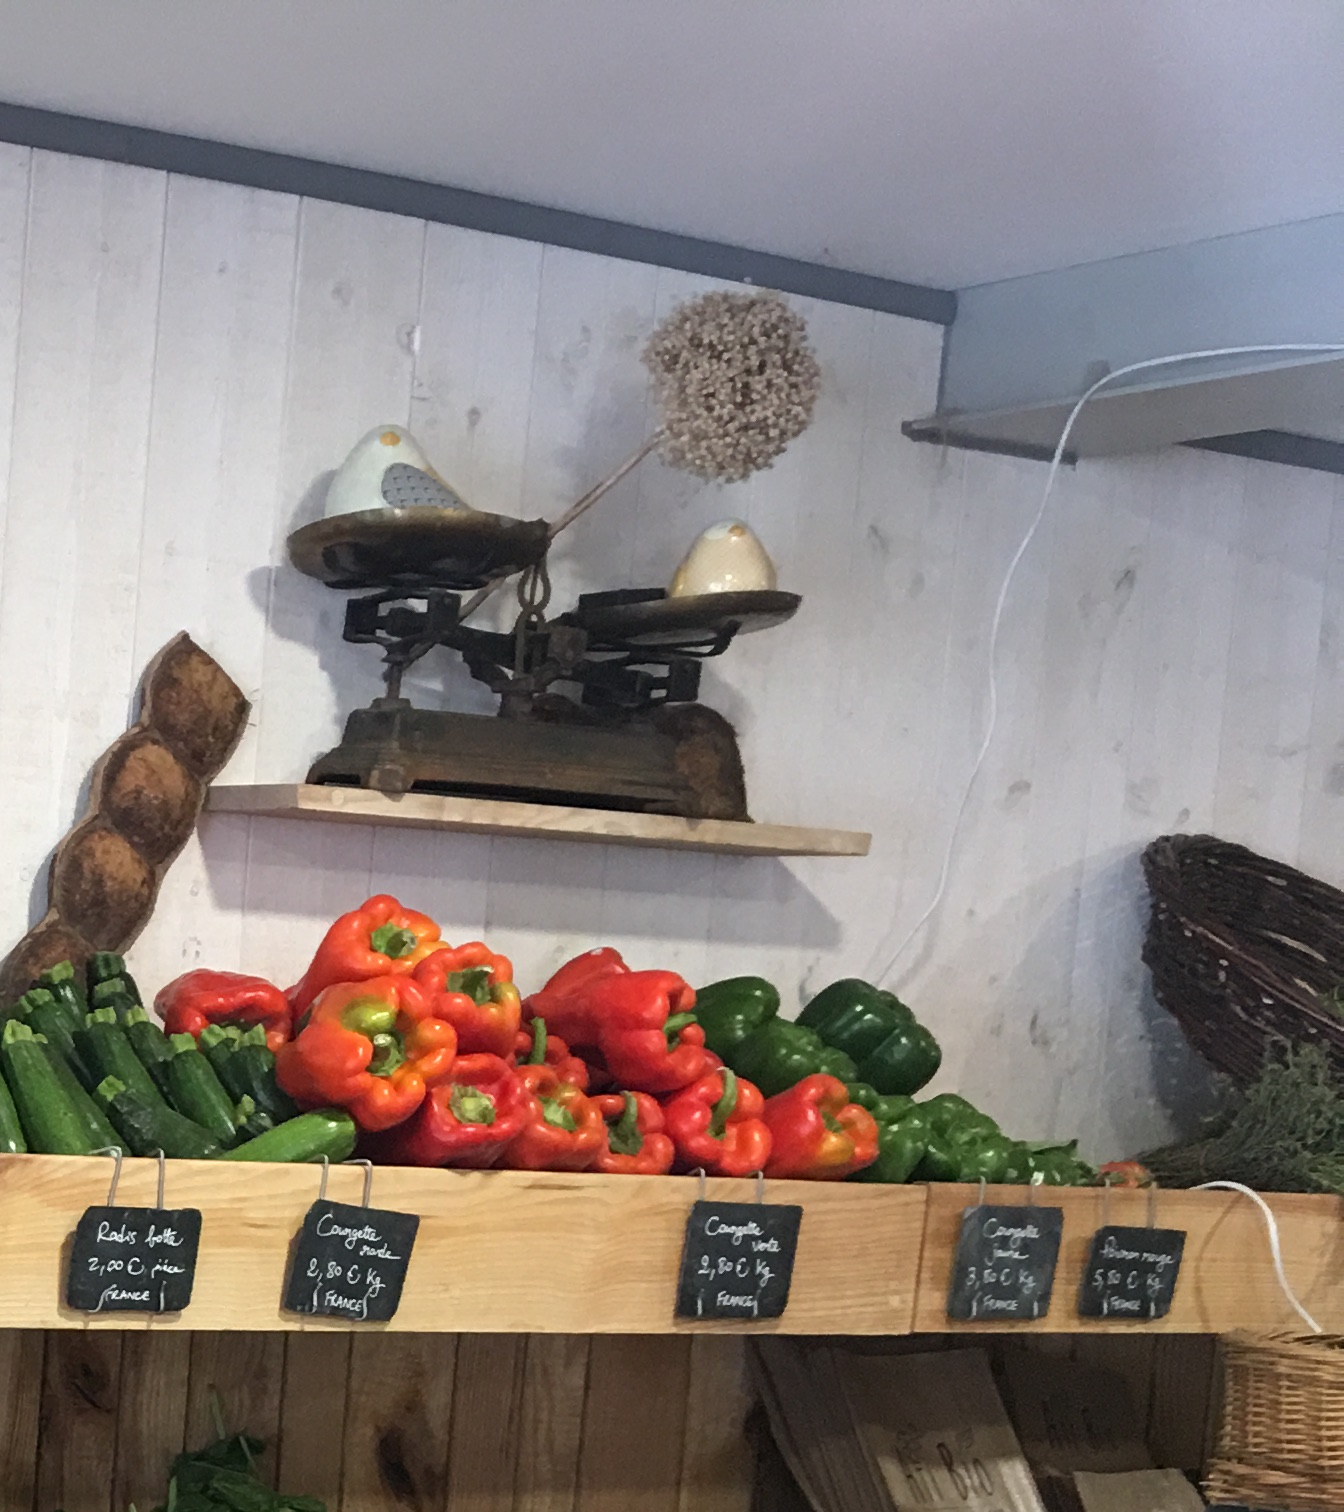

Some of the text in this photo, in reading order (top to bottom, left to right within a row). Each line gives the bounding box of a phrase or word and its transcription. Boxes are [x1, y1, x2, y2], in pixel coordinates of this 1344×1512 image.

[97, 1221, 137, 1245] Radis
[316, 1213, 382, 1250] Courgette
[105, 1289, 150, 1301] FRANCE
[324, 1289, 363, 1312] FRANCE
